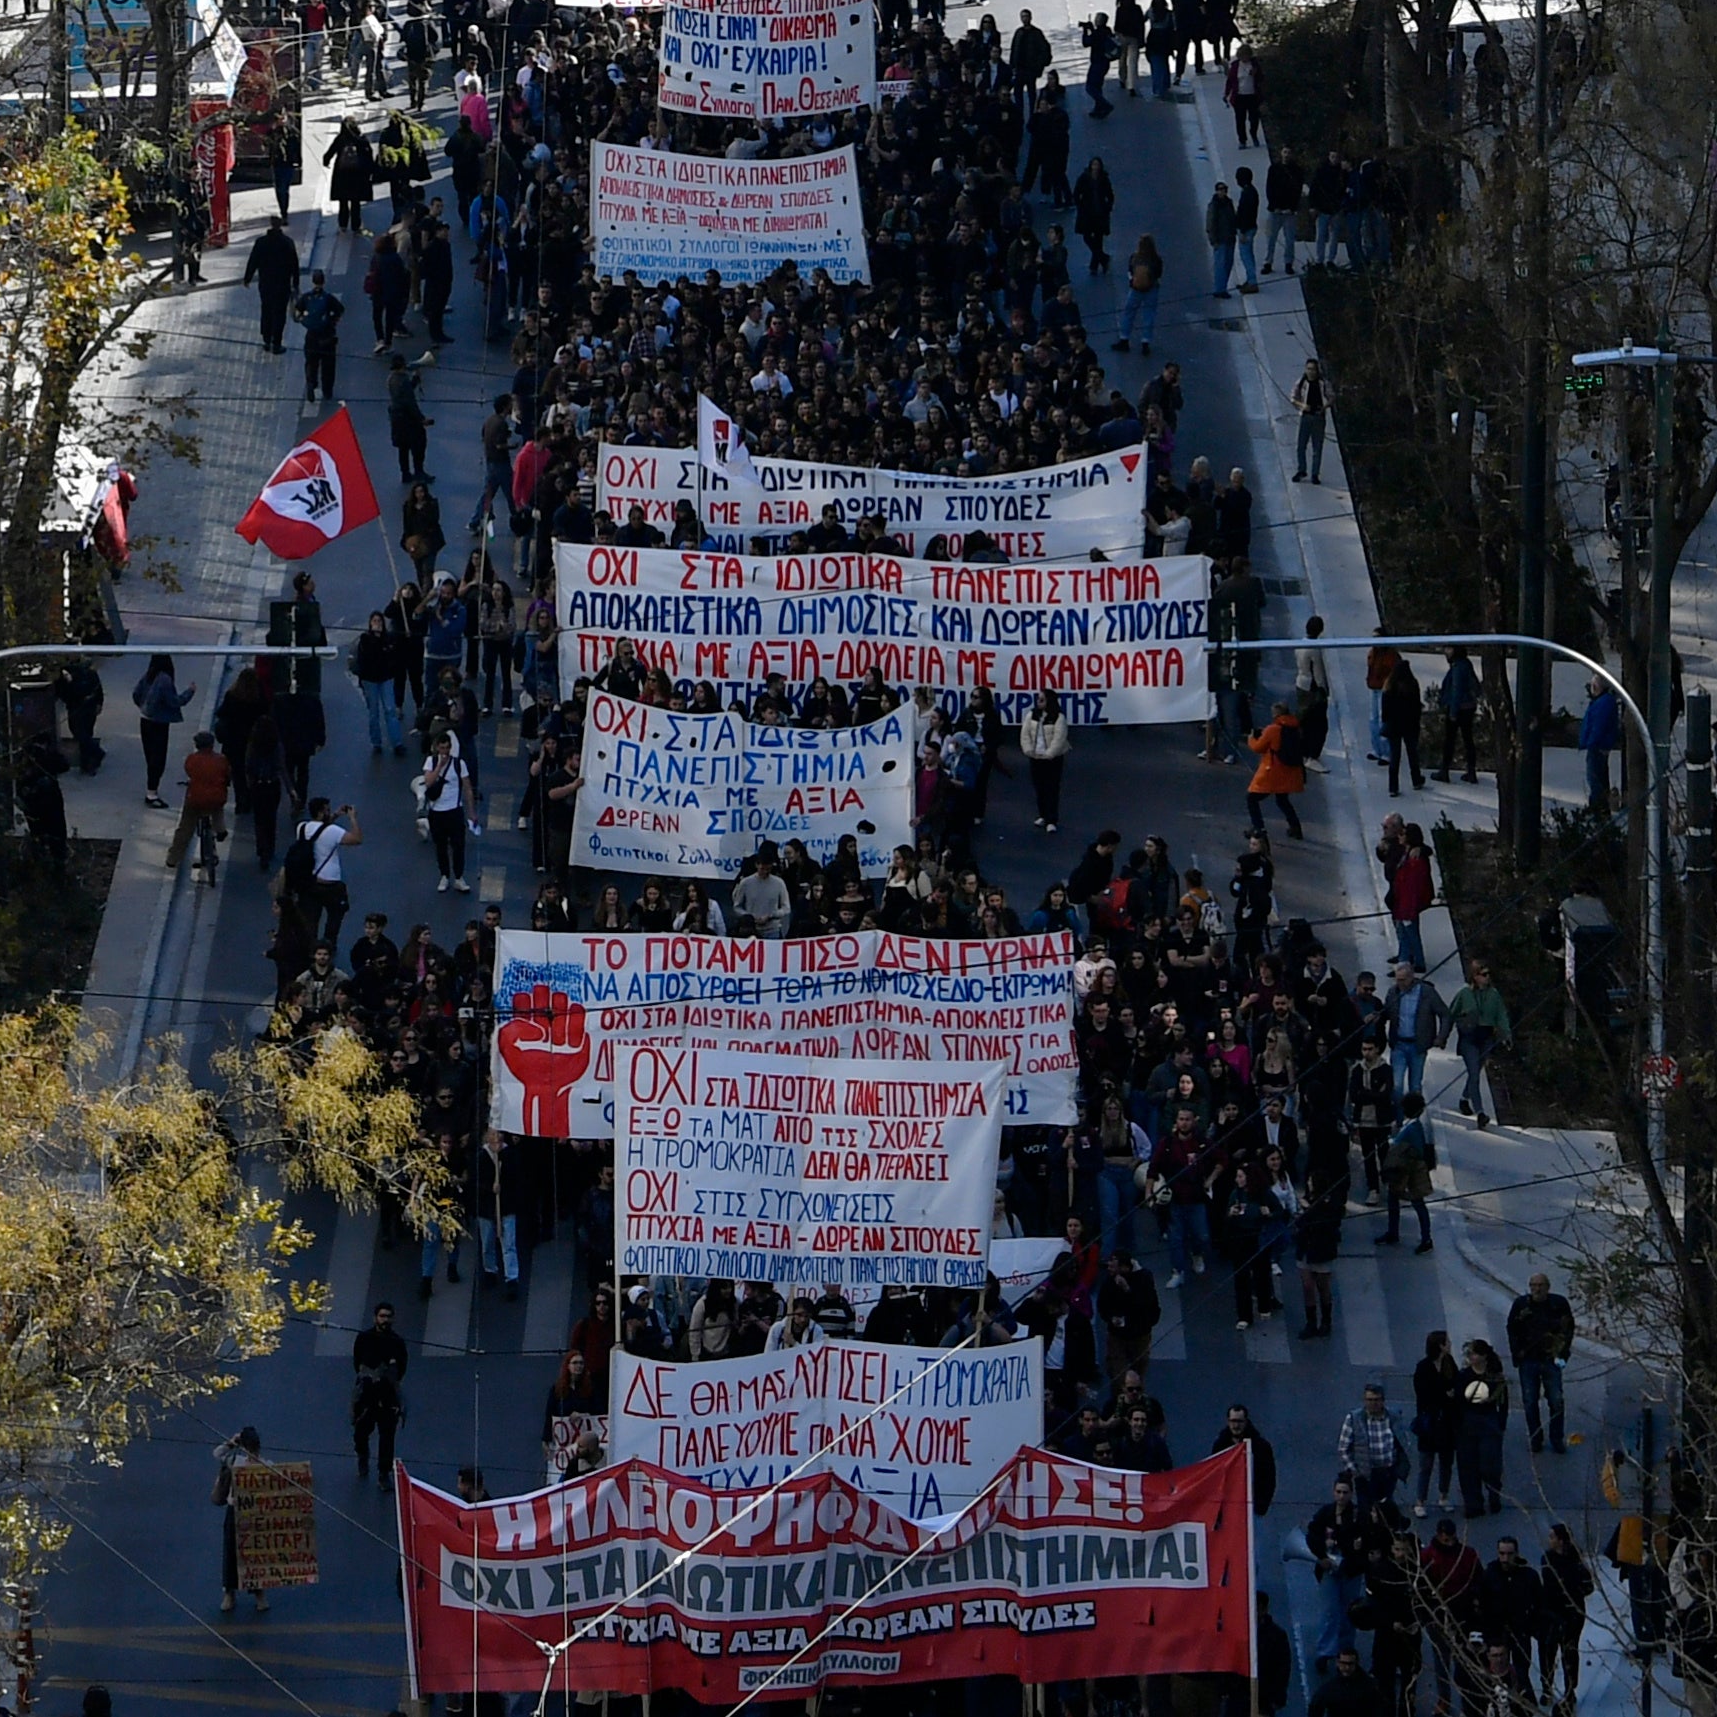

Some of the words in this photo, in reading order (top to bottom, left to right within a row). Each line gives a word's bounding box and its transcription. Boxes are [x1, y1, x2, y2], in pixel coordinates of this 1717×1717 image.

[717, 15, 758, 41] ΕΙΝΑΙ
[770, 12, 837, 42] ΔΙΚΑΙΩΜΑ
[664, 34, 682, 64] ΚΑΙ
[691, 41, 721, 70] ΟΧΙ
[732, 42, 828, 76] ΕΥΚΑΙΡΙΑ!
[605, 149, 631, 174] ΟΧΙ
[634, 155, 667, 179] ΣΤΑ
[673, 161, 748, 186] ΙΔΙΩΤΙΚΑ
[750, 155, 847, 187] ΠΑΝΕΠΙΣΤΗΜΙΑ
[599, 176, 665, 201] ΑΠΟΚΛΕΙΣΤΙΚΑ
[666, 187, 717, 209] ΔΗΜΟΣΙΕΣ
[731, 193, 773, 209] ΔΩΡΕΑΝ
[780, 188, 834, 208] ΣΠΟΥΔΕΣ
[599, 201, 637, 223] ΠΤΥΧΙΑ
[642, 206, 660, 224] ΜΕ
[662, 206, 687, 226] ΑΞΙΑ
[743, 216, 760, 233] ΜΕ
[601, 236, 672, 254] ΦΟΙΤΗΤΙΚΟΙ
[679, 239, 740, 255] ΣΥΛΛΟΓΟΙ
[605, 455, 657, 490] ΟΧΙ
[709, 502, 741, 525] ΜΕ
[944, 494, 1052, 523] ΣΠΟΥΔΕΣ
[587, 548, 638, 586] ΟΧΙ
[680, 552, 743, 590] ΣΤΑ
[776, 555, 903, 595] ΙΔΙΩΤΙΚΑ
[930, 563, 1162, 605] ΠΑΝΕΠΙΣΤΗΜΙΑ
[569, 590, 762, 635] ΑΠΟΚΛΕΙΣΤΙΚΑ
[778, 593, 919, 636] ΔΗΜΟΣΙΕΣ
[932, 605, 973, 643] ΚΑΙ
[980, 608, 1089, 646] ΔΩΡΕΑΝ
[1104, 599, 1208, 644] ΣΠΟΥΔΕΣ
[576, 633, 678, 677] ΠΤΧΙΑ
[695, 641, 732, 679] ΜΕ
[957, 650, 997, 688] ΜΕ
[1009, 647, 1184, 692] ΔΙΚΑΙΩΜΑΤΑ
[593, 695, 648, 743] ΟΧΙ
[665, 714, 736, 752] ΣΤΑ
[750, 716, 902, 750] ΙΔΙΩΤΙΚΑ
[615, 740, 866, 785] ΠΑΝΕΠΙΣΤΗΜΙΑ
[603, 772, 700, 809] ΠΤΥΧΙΑ
[726, 787, 758, 807] ΜΕ
[785, 786, 865, 815] ΑΞΙΑ
[596, 806, 680, 834] ΔΩΡΕΑΝ
[706, 808, 812, 835] ΣΠΟΥΔΕΣ
[582, 937, 628, 972] ΤΟ
[645, 937, 765, 974] ΠΟΤΑΜΙ
[783, 936, 860, 971] ΠΙΣΩ
[875, 934, 951, 974] ΔΕΝ
[958, 930, 1073, 974] ΓΥΡΝΑ!
[583, 972, 621, 1003] ΝΑ
[626, 973, 762, 1005] ΑΠΟΣΥΡΘΕΙ
[773, 972, 824, 1003] ΤΩΡΑ
[829, 971, 856, 995] ΤΟ
[600, 1007, 637, 1031] ΟΧΙ
[642, 1006, 678, 1030] ΣΤΑ
[684, 1005, 772, 1031] ΙΔΙΩΤΙΚΑ
[1030, 1034, 1059, 1051] ΓΙΑ
[629, 1047, 698, 1107] ΟΧΙ
[704, 1076, 740, 1108] ΣΤΑ
[744, 1072, 837, 1115] ΙΔΙΩΤΙΚΑ
[844, 1079, 987, 1118] ΠΑΝΕΠΙΣΤΗΜΙΑ
[629, 1106, 681, 1137] ΕΞΩ
[689, 1116, 714, 1138] ΤΑ
[721, 1110, 769, 1141] ΜΑΤ
[773, 1115, 813, 1145] ΑΠΟ
[822, 1127, 859, 1149] ΤΙΣ
[868, 1119, 945, 1151] ΣΧΟΛΕΣ
[627, 1139, 644, 1167] Η
[652, 1139, 796, 1178] ΤΡΟΜΟΚΡΑΤΙΑ
[803, 1151, 840, 1181] ΔΕΝ
[843, 1153, 871, 1182] ΘΑ
[874, 1152, 949, 1182] ΠΕΡΑΣΕΙ
[627, 1169, 679, 1213] ΟΧΙ
[693, 1190, 747, 1218] ΣΤΙΣ
[757, 1188, 897, 1224] ΣΥΓΧΩΝΕΥΣΕΙΣ
[626, 1214, 704, 1245] ΠΤΥΧΙΑ
[712, 1226, 738, 1246] ΜΕ
[743, 1222, 791, 1250] ΑΞΙΑ
[812, 1226, 885, 1253] ΔΩΡΕΑΝ
[890, 1227, 983, 1255] ΣΠΟΥΔΕΣ
[624, 1245, 700, 1275] ΦΟΙΤΗΤΙΚΟΙ
[706, 1249, 766, 1278] ΣΥΛΛΟΓΟΙ
[768, 1256, 847, 1284] ΔΗΜΟΚΡΙΤΕΙΟΥ
[850, 1256, 939, 1285] ΠΑΝΕΠΙΣΤΗΜΙΟΥ
[944, 1259, 987, 1285] ΘΡΑΚΗΣ
[623, 1363, 677, 1418] ΔΕ
[691, 1380, 730, 1415] ΘΑ
[736, 1368, 787, 1411] ΜΑΣ
[794, 1346, 888, 1405] ΛΥΓΙΣΕΙ
[894, 1370, 915, 1406] Η
[917, 1355, 1031, 1408] ΤΡΟΜΟΚΡΑΤΙΑ
[660, 1413, 799, 1469] ΠΑΛΕΥΟΥΜΕ
[809, 1424, 835, 1455] ΓΙΑ
[840, 1413, 877, 1457] ΝΑ
[493, 1498, 539, 1551] Η
[547, 1469, 909, 1551] ΠΛΕΙΟΨΗΦΙΑ
[239, 1533, 310, 1551] ΖΕΥΓΑΡΙ
[450, 1558, 534, 1610] ΟΧΙ
[546, 1546, 626, 1607] ΣΤΑ
[636, 1546, 826, 1613] ΙΔΙΩΤΙΚΑ
[832, 1530, 1201, 1599] ΠΑΝΕΠΙΣΤΗΜΙΑ!
[572, 1614, 676, 1644] ΠΤΥΧΙΑ
[682, 1628, 723, 1656] ΜΕ
[728, 1627, 811, 1655] ΑΞΙΑ
[826, 1603, 954, 1642] ΔΩΡΕΑΝ
[962, 1599, 1097, 1634] ΣΠΟΥΔΕΣ
[822, 1652, 900, 1674] ΣΥΛΛΟΓΟΙ
